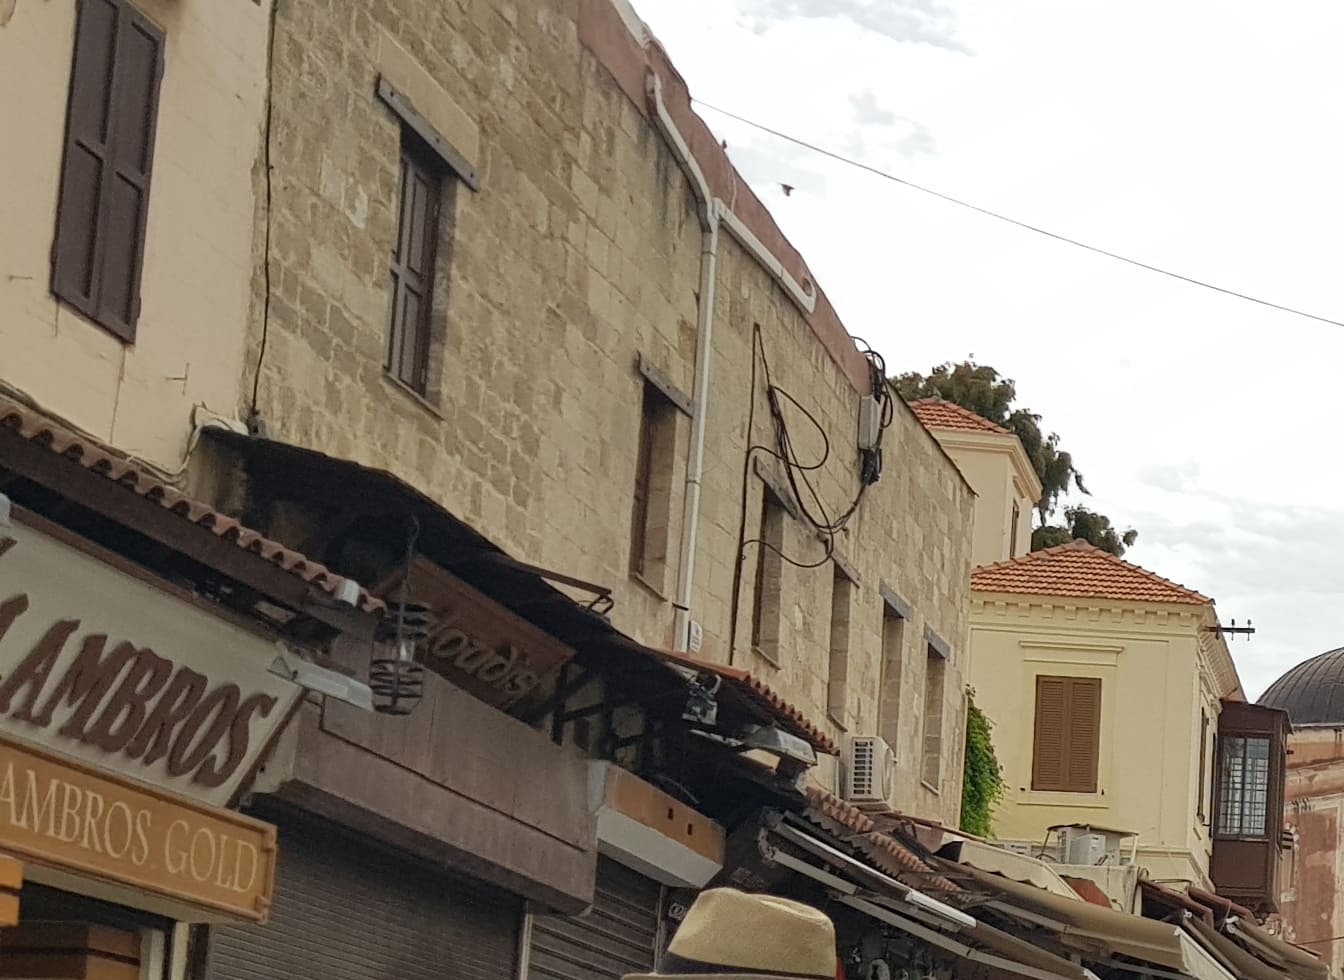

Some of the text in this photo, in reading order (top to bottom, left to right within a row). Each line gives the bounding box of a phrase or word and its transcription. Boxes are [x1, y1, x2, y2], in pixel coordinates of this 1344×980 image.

[0, 593, 278, 788] AMBROS
[0, 761, 259, 893] AMBROS GOLD
